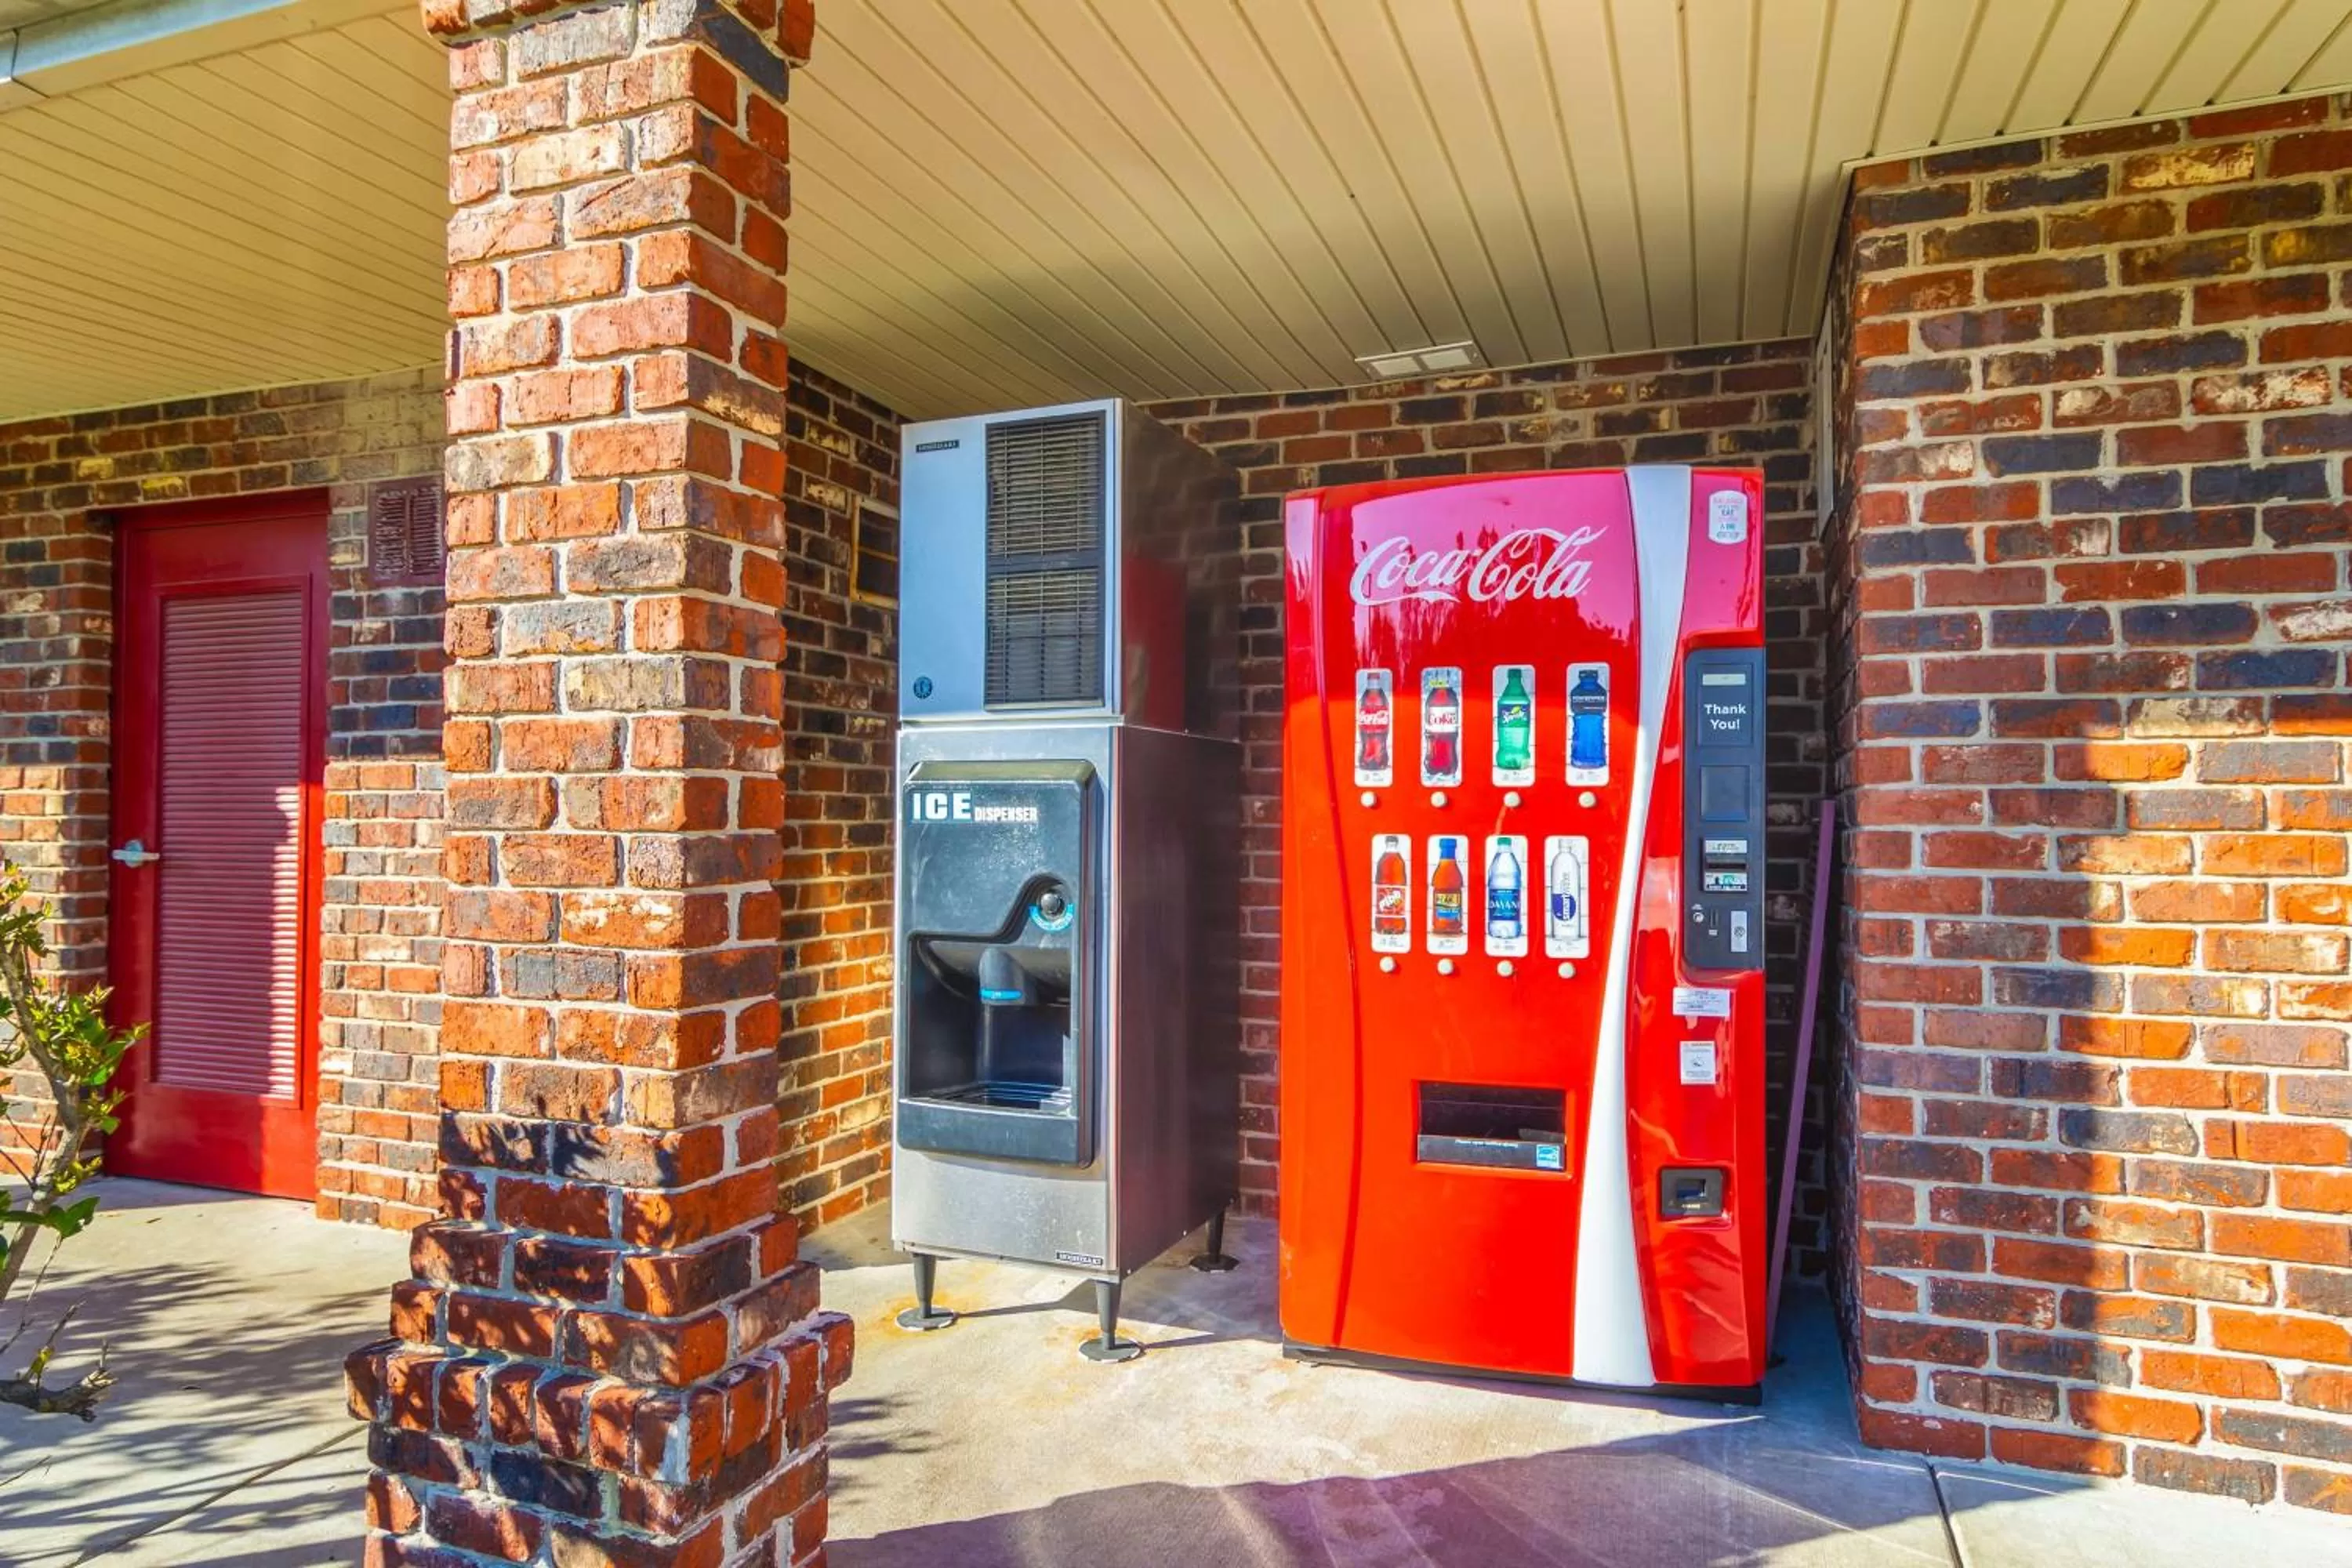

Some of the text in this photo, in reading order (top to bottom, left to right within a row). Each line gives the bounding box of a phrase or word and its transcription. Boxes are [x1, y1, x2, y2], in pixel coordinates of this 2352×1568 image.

[1349, 525, 1609, 606] Coca-Cola
[1704, 703, 1747, 715] Thank
[1710, 718, 1740, 730] You!
[913, 793, 1039, 822] ICE DISPENSER
